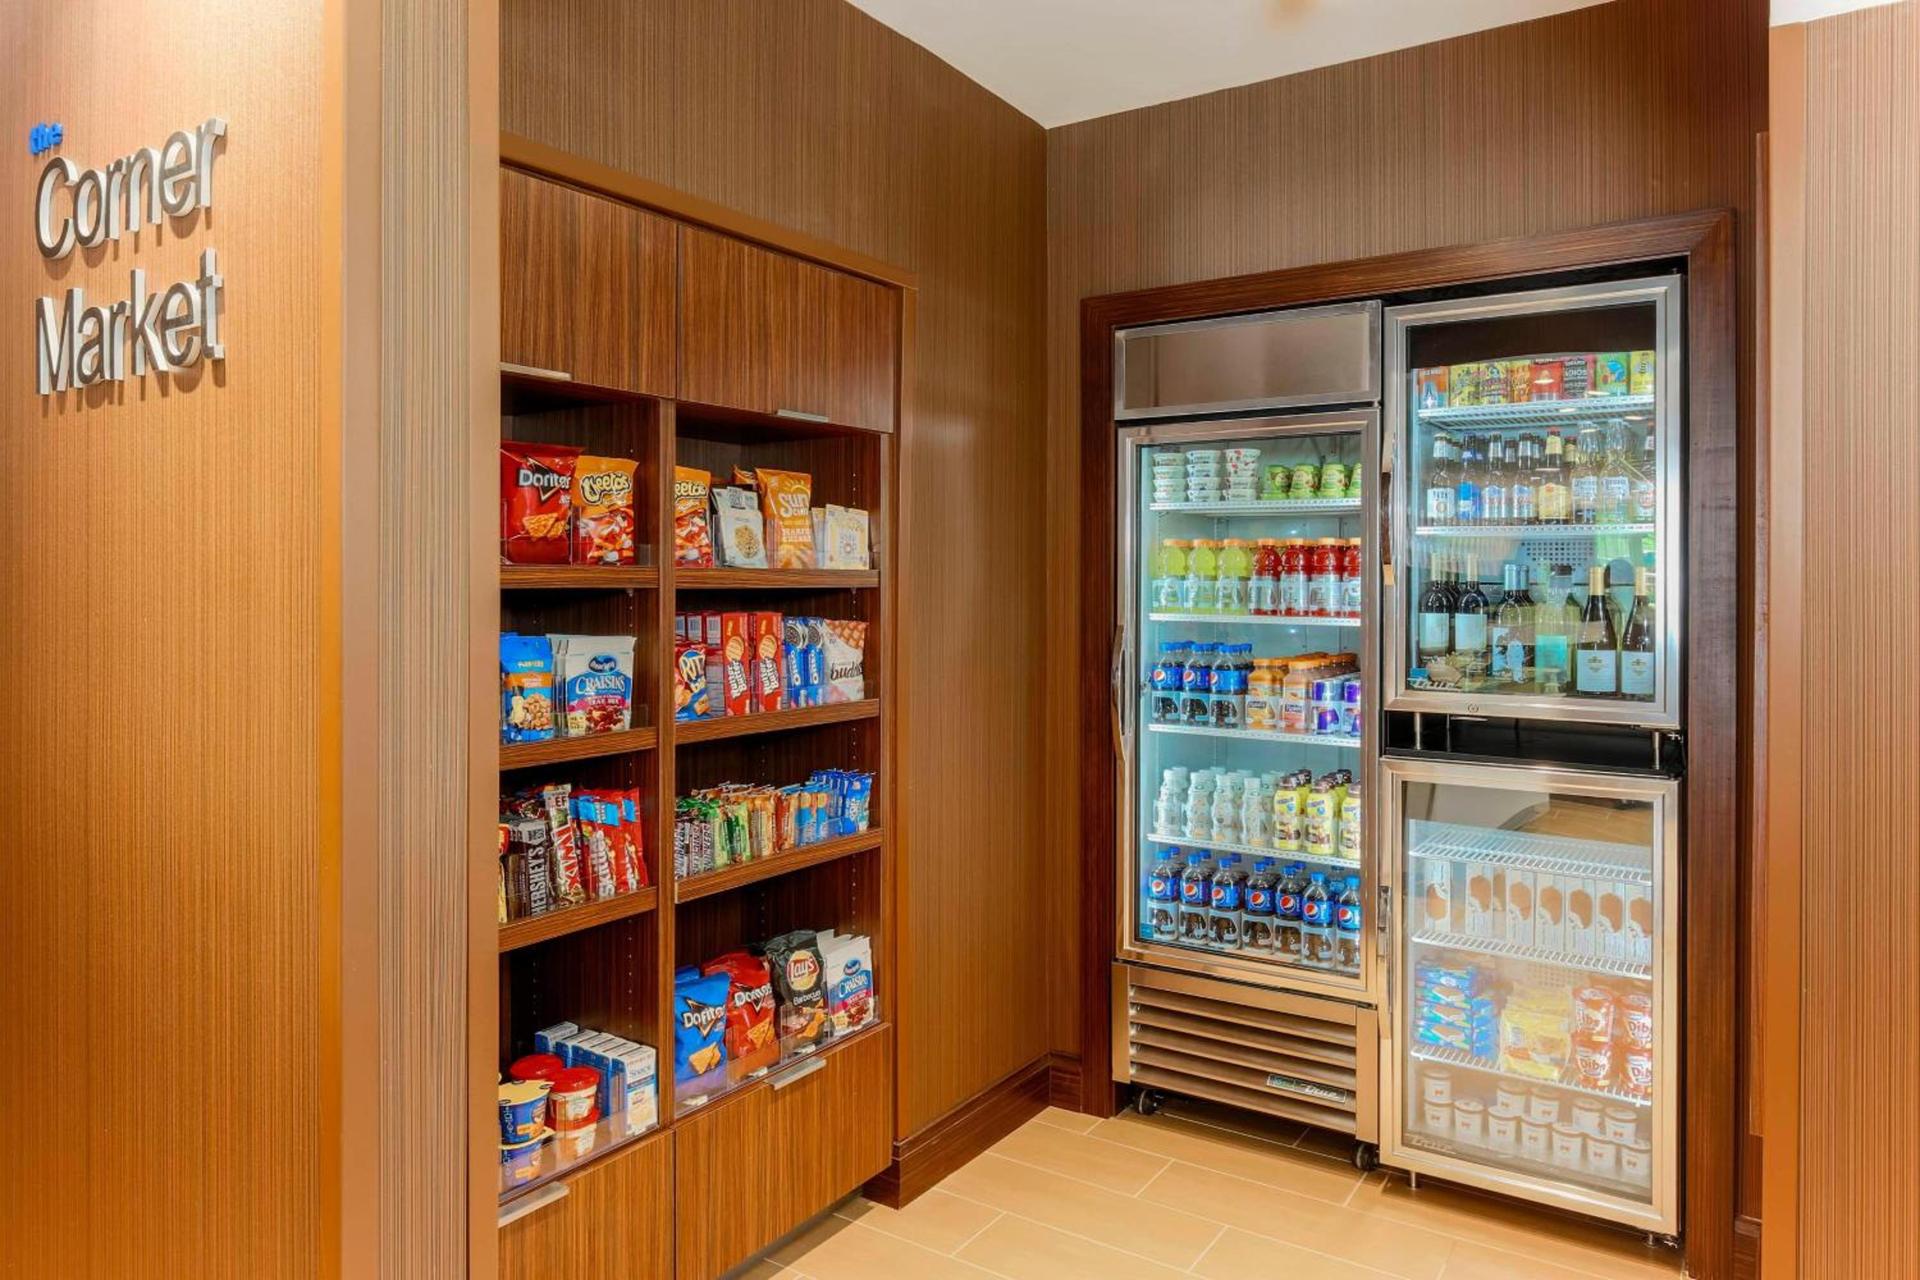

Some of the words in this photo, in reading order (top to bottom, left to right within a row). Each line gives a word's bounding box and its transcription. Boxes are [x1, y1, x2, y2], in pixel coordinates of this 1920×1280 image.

[30, 122, 63, 155] the
[35, 117, 228, 259] Corner
[36, 247, 225, 395] Market
[580, 472, 632, 503] Cheetos
[675, 480, 708, 497] eetos
[528, 845, 547, 917] HERSHEY'S
[1628, 1019, 1651, 1033] Dib
[1631, 1066, 1651, 1079] Dib
